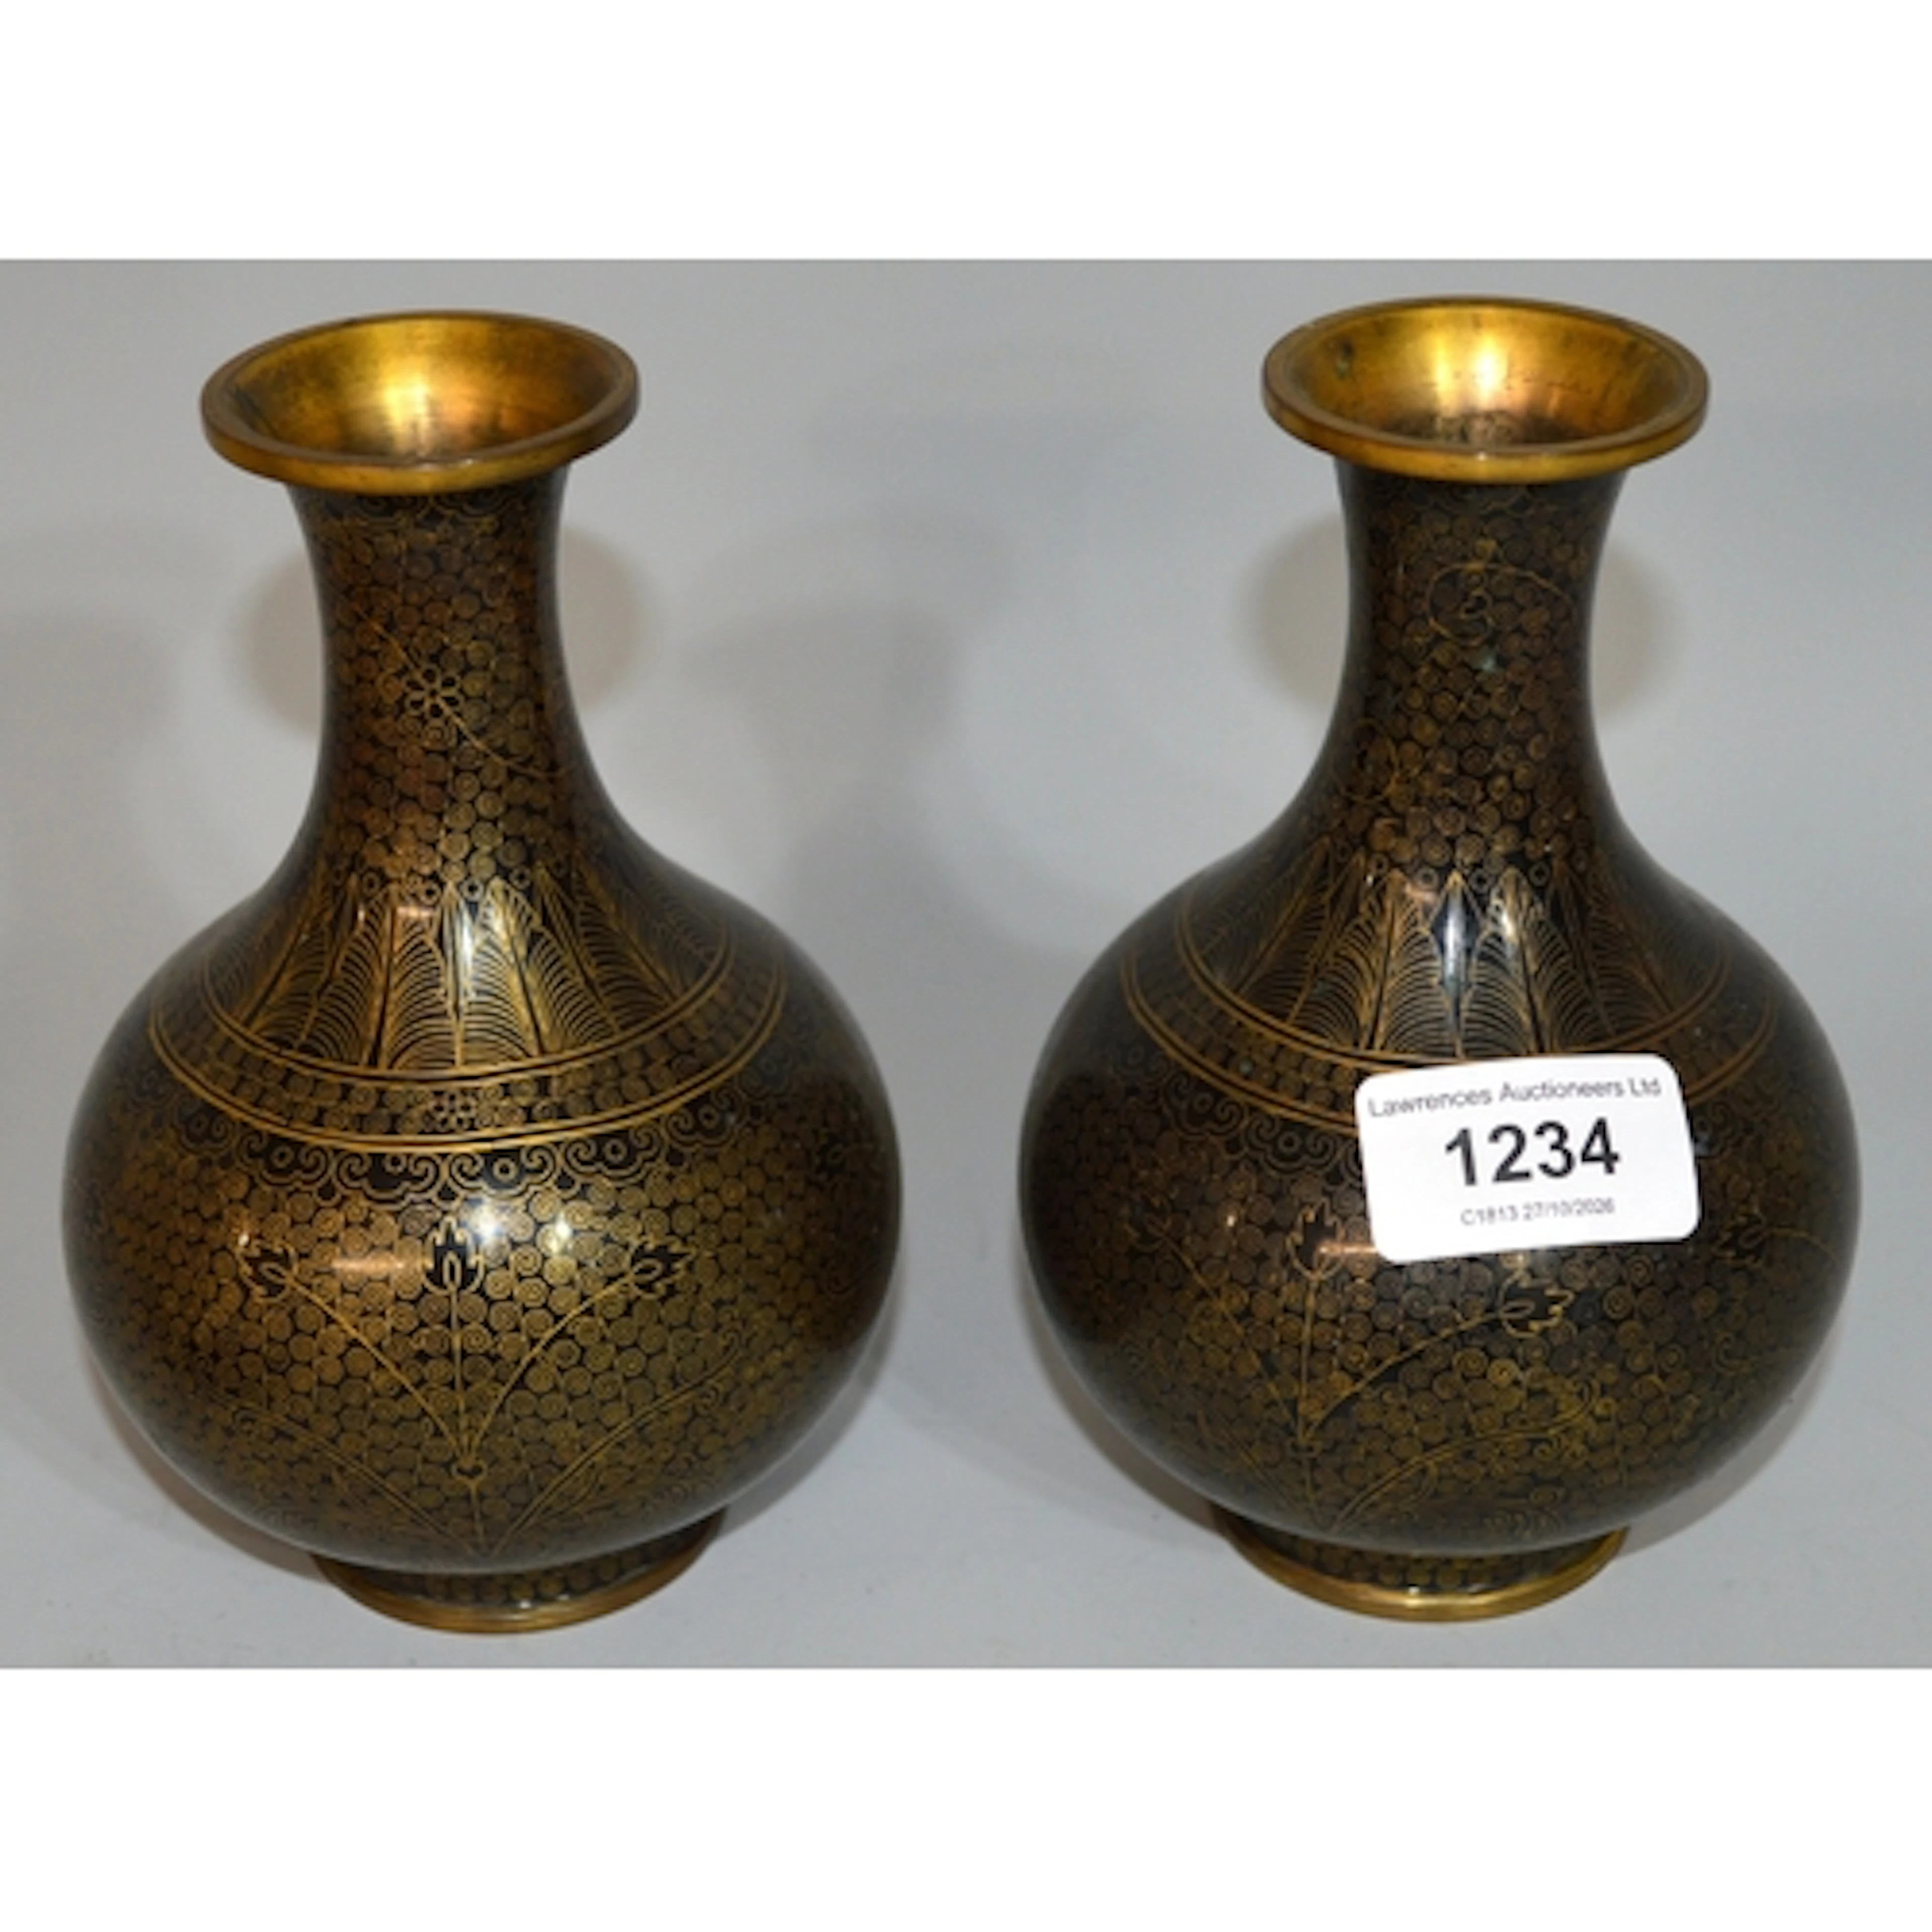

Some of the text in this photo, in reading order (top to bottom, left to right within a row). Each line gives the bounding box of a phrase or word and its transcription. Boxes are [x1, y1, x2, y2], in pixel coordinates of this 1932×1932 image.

[1368, 1078, 1662, 1118] Lawrences Auctioneers Ltd
[1445, 1117, 1620, 1186] 1234
